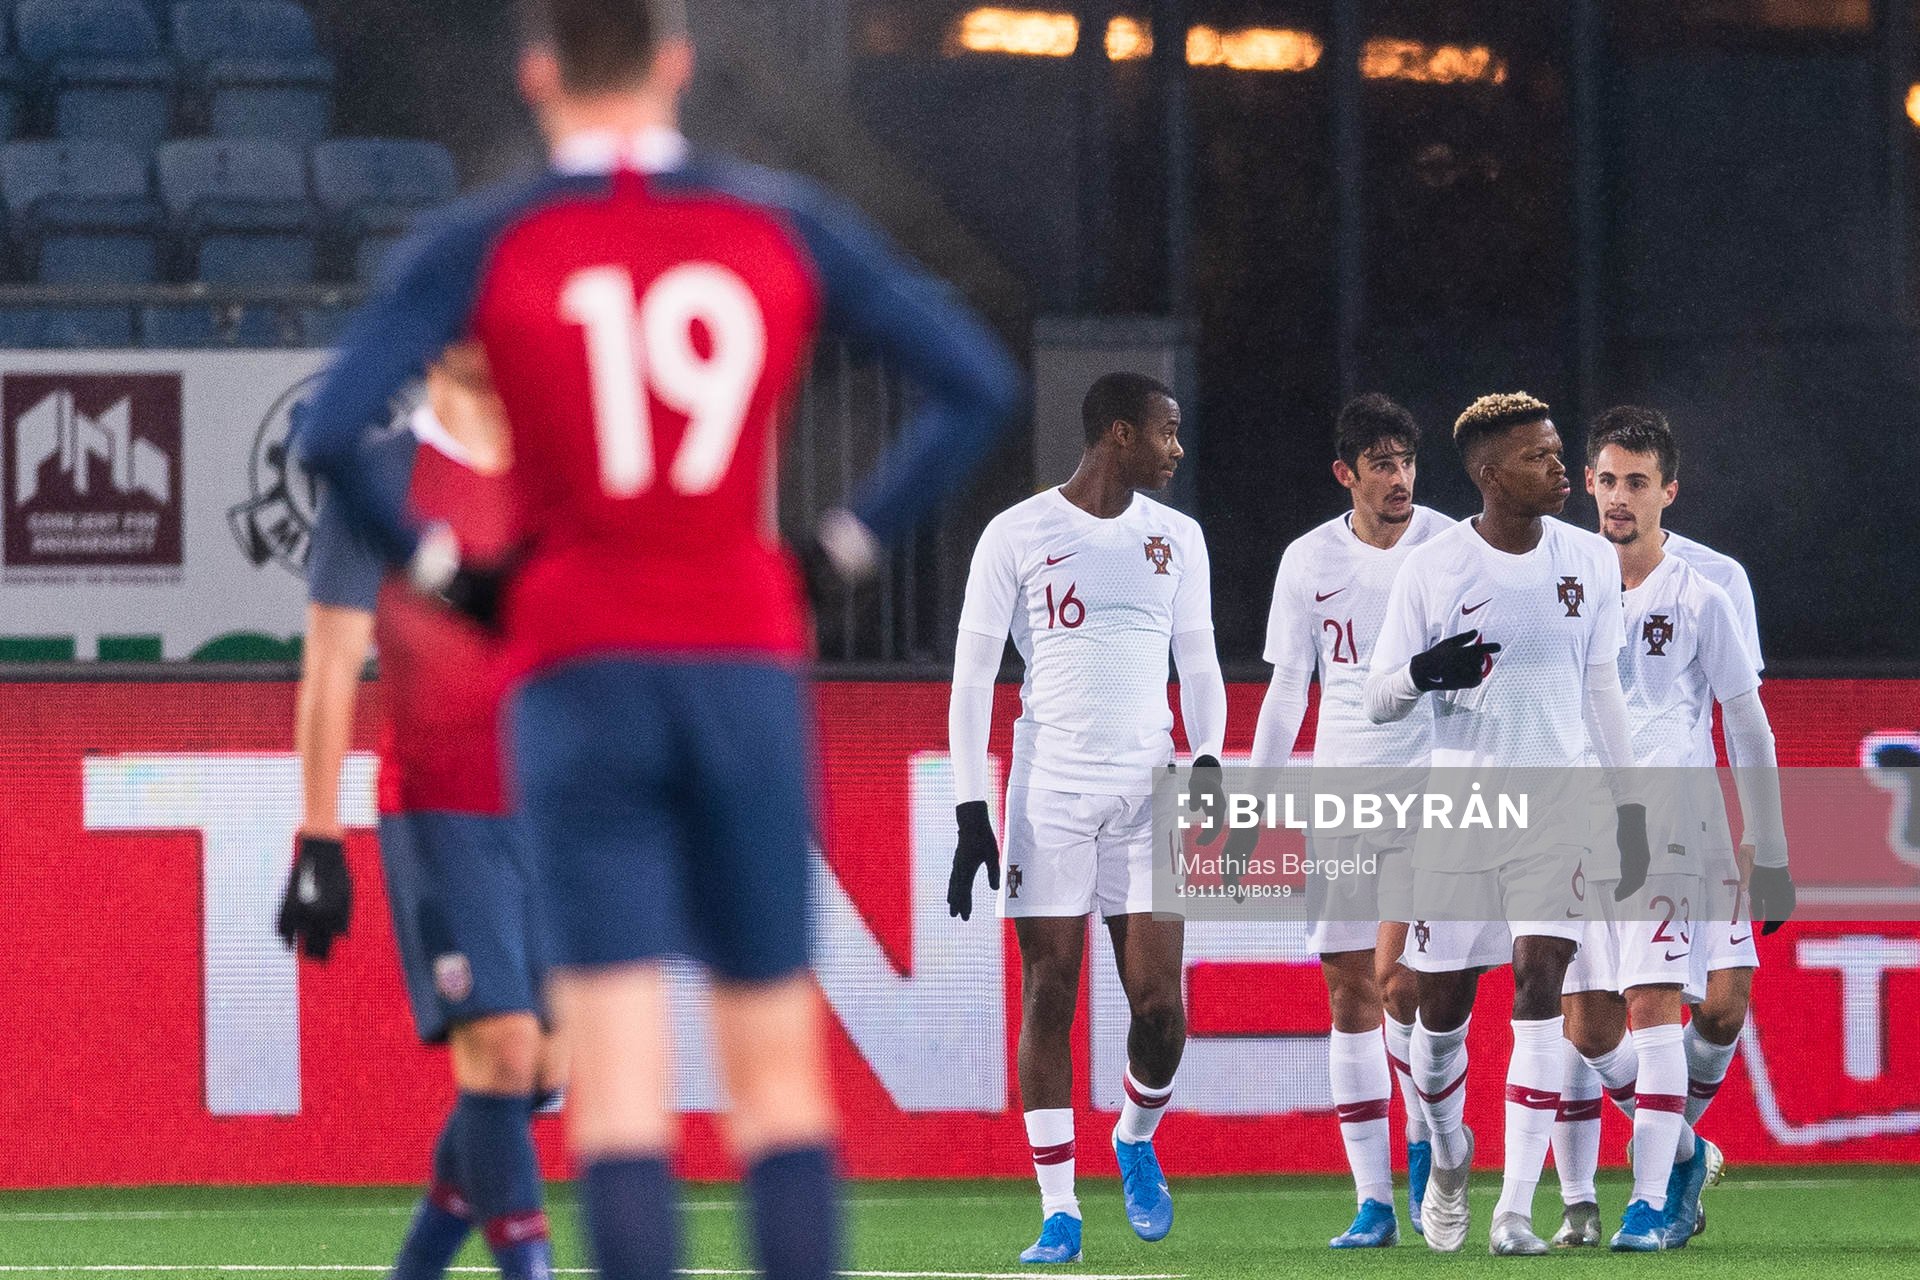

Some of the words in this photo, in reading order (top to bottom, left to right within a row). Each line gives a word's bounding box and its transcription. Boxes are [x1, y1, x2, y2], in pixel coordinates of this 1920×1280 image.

[558, 262, 768, 498] 19
[1045, 581, 1086, 629] 16
[1323, 618, 1359, 664] 21
[83, 752, 1345, 1115] TNE
[1649, 895, 1690, 944] 23
